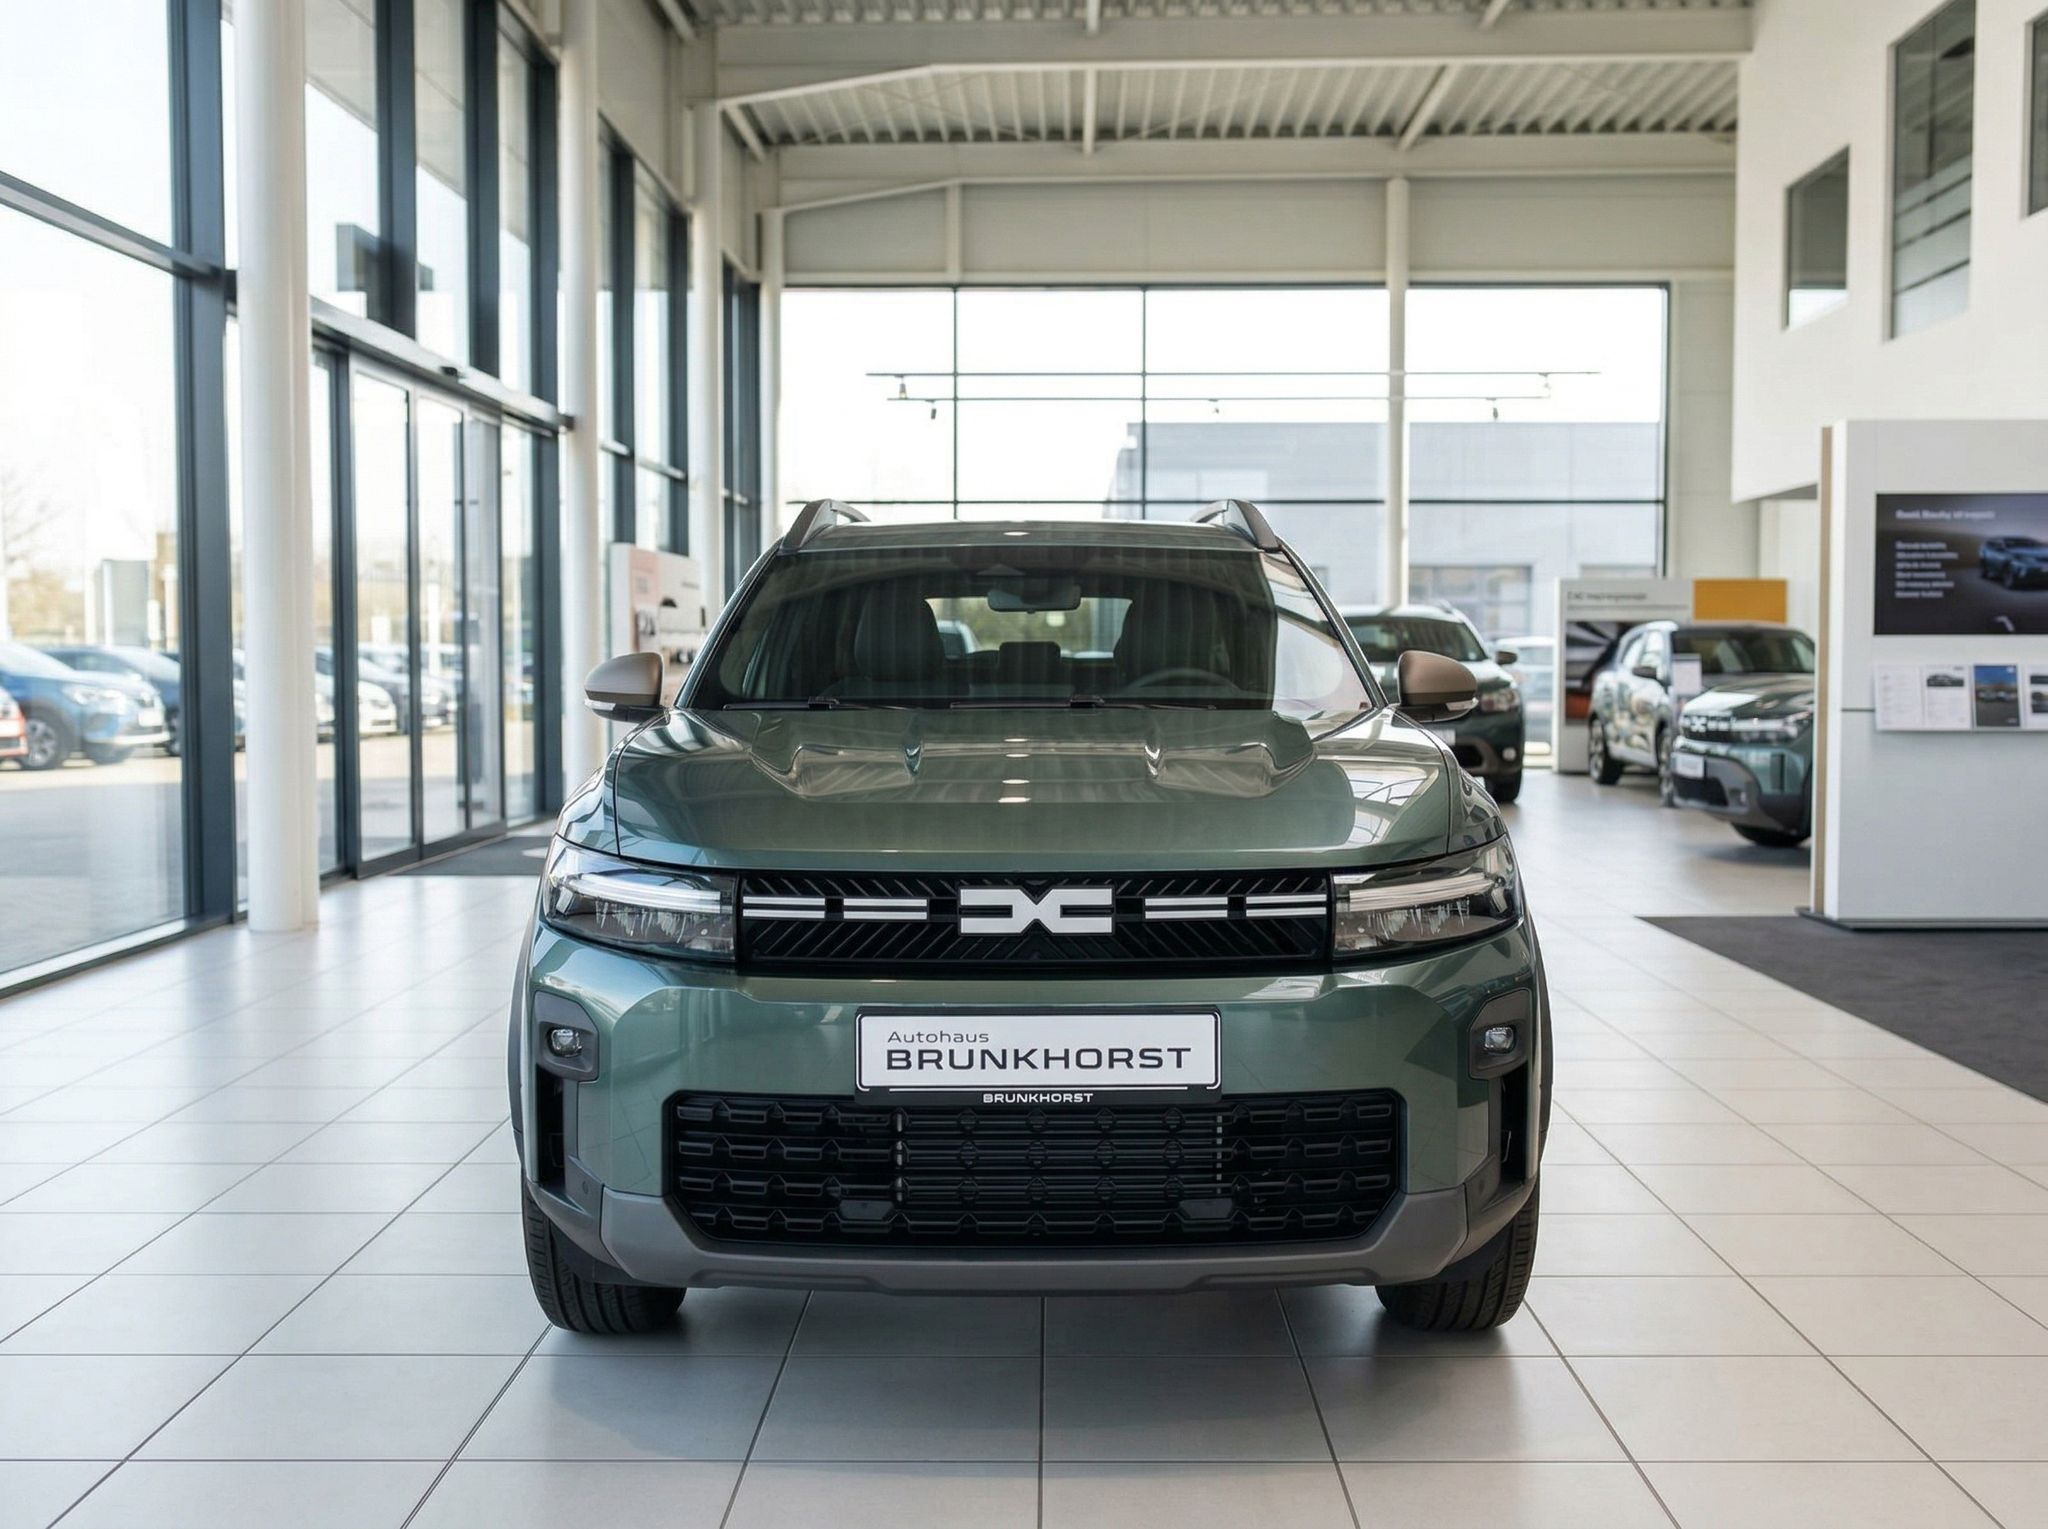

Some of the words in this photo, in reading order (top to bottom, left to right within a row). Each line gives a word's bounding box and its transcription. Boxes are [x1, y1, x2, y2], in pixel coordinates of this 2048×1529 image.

[887, 1030, 989, 1043] Autohaus
[886, 1047, 1192, 1071] BRUNKHORST
[983, 1092, 1094, 1104] BRUNKHORST
